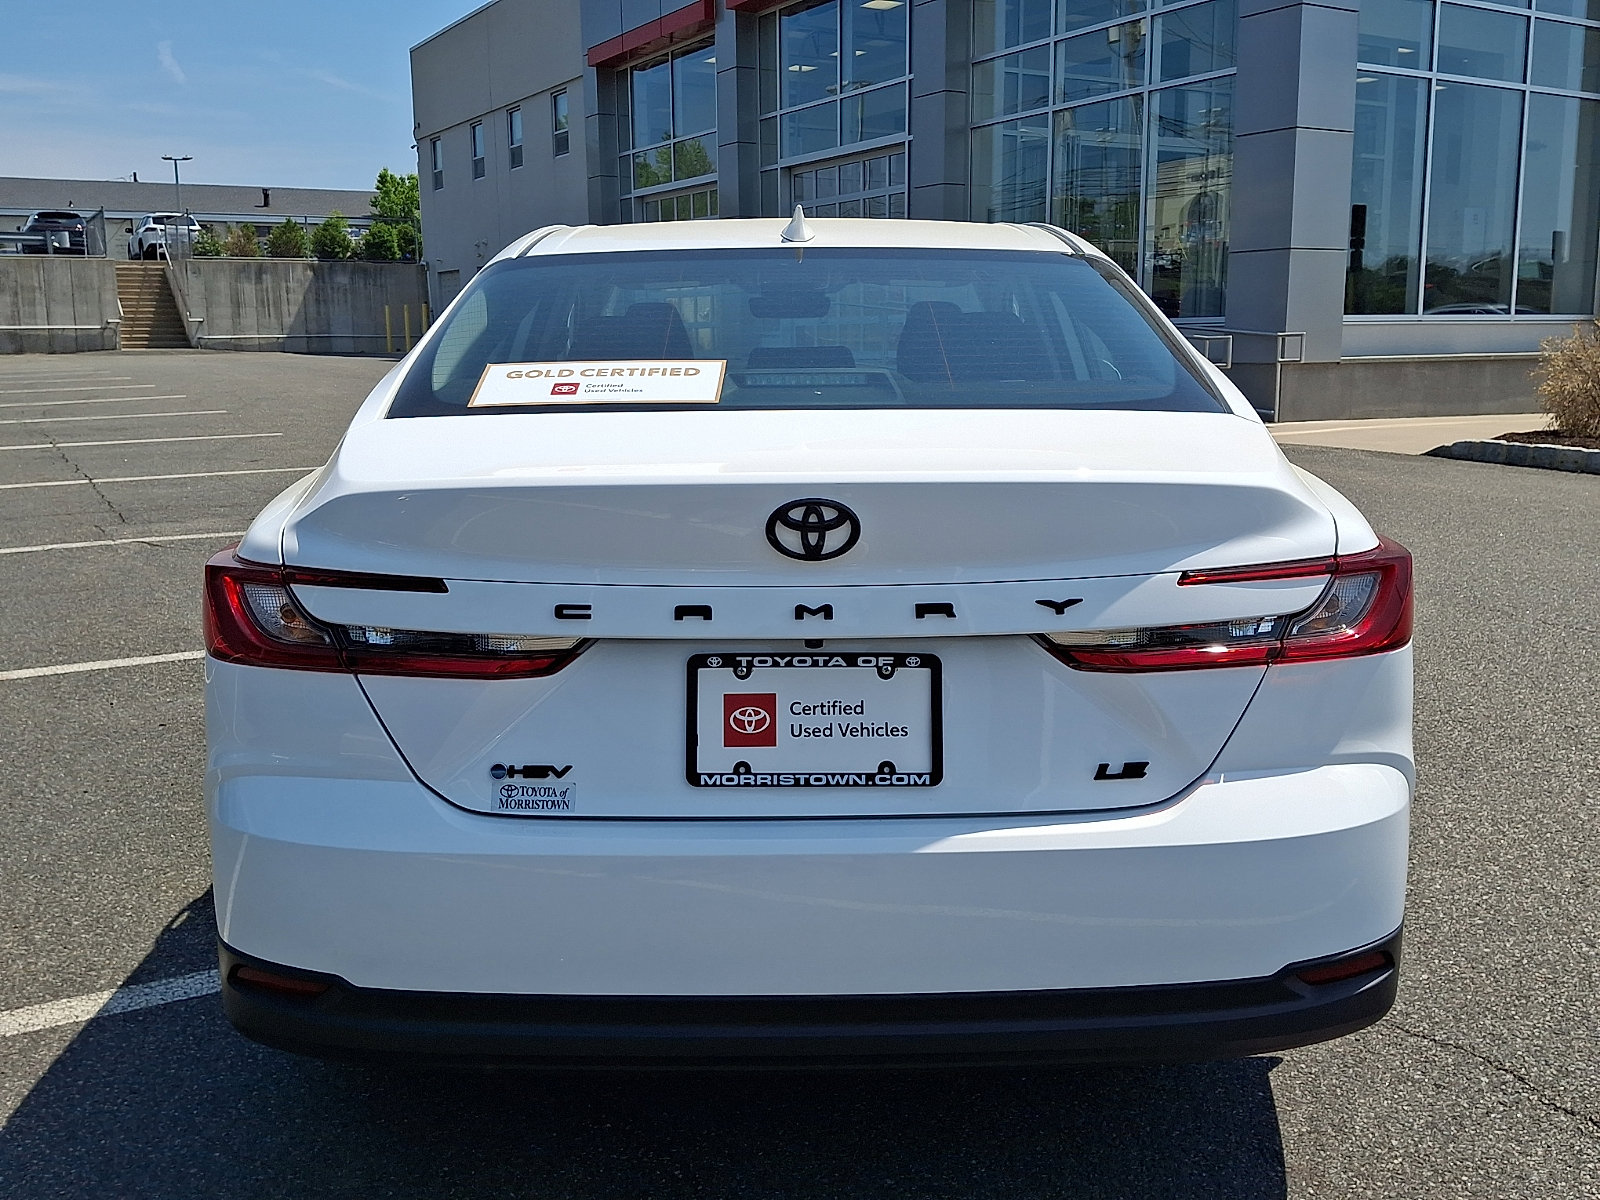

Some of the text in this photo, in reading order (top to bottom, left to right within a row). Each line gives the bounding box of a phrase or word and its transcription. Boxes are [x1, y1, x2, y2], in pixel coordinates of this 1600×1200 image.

[506, 367, 701, 379] GOLD CERTIFIED
[554, 598, 1084, 621] CAMRY
[736, 656, 894, 667] TOYOTA OF
[789, 700, 865, 716] Certified
[790, 722, 909, 738] Used Vehicles
[1093, 761, 1150, 780] LE
[700, 774, 930, 785] MORRISTOWN.COM
[520, 785, 570, 799] TOYOTA of
[498, 798, 570, 810] MORRISTOWN
